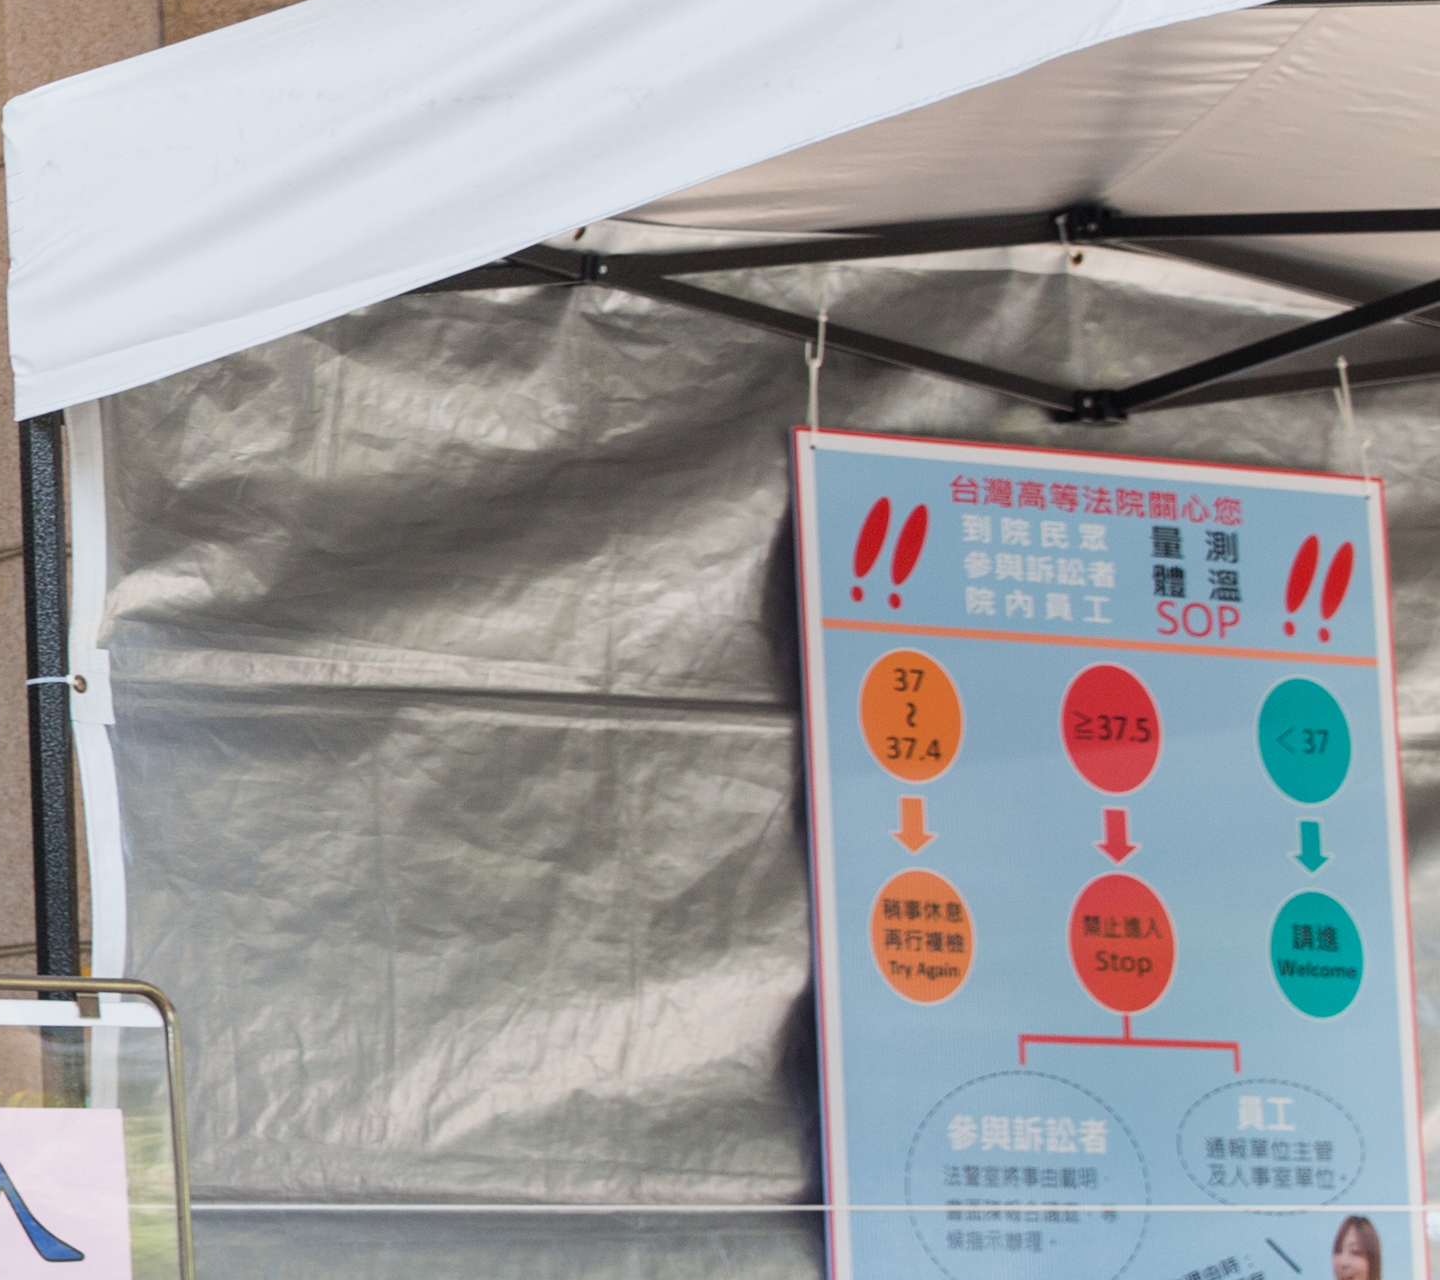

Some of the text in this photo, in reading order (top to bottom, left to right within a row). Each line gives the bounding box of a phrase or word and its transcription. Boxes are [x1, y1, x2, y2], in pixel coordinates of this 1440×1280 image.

[949, 474, 1244, 526] 台灣高等法院關心您
[961, 514, 1108, 552] 到院民眾
[1150, 525, 1240, 564] 量測
[965, 586, 1113, 625] 院內員工
[1156, 600, 1241, 639] SOP
[893, 669, 924, 692] 37
[885, 736, 942, 762] 37.4
[889, 960, 961, 980] Try Again
[1096, 950, 1153, 977] Stop
[1276, 957, 1358, 980] Welcome
